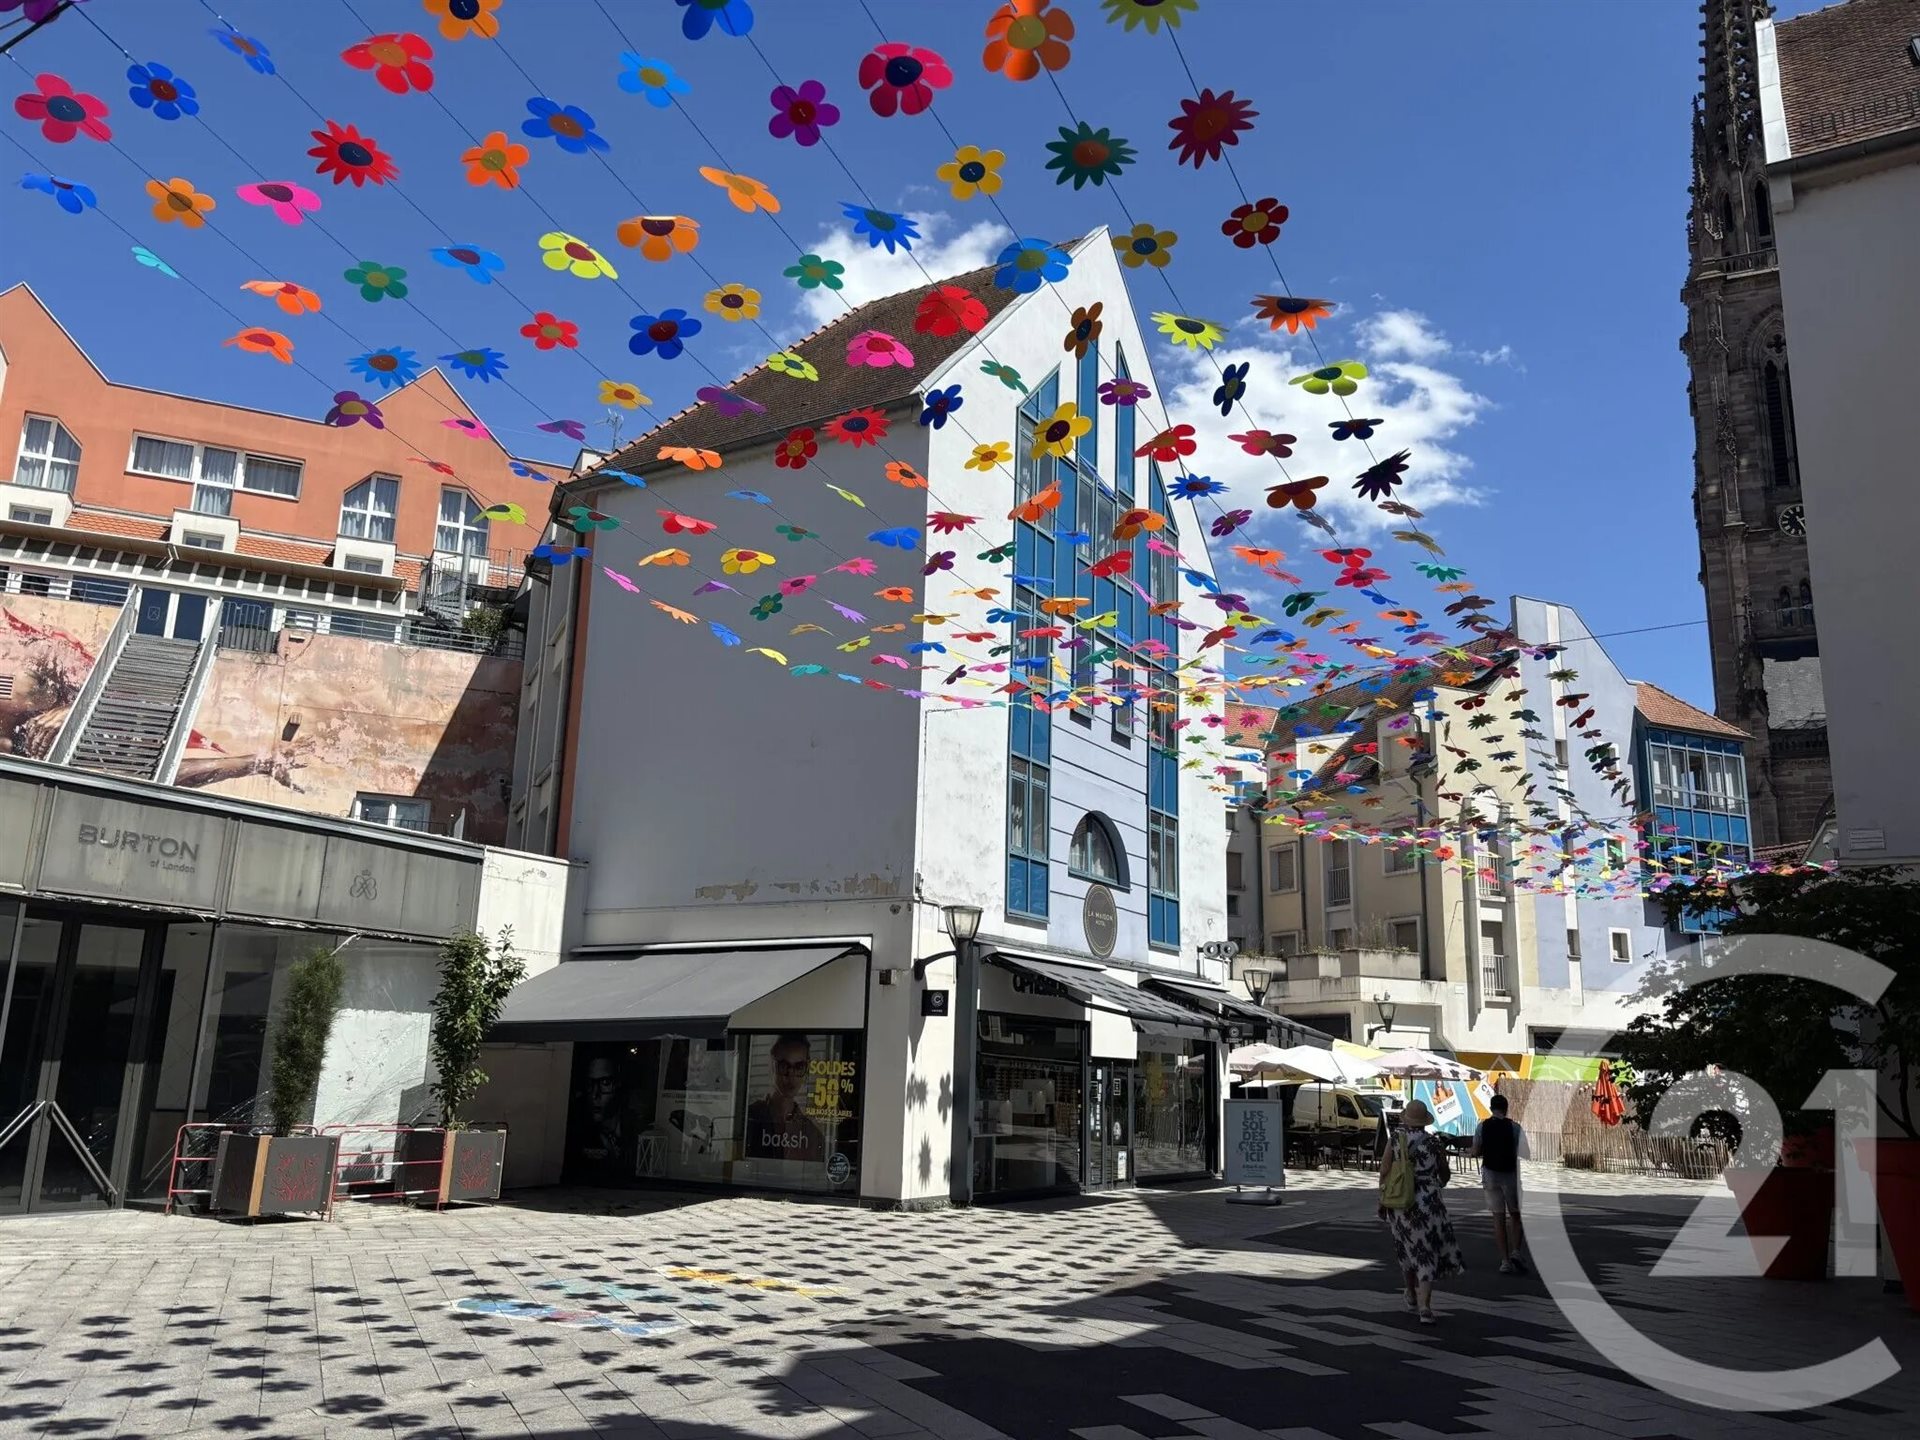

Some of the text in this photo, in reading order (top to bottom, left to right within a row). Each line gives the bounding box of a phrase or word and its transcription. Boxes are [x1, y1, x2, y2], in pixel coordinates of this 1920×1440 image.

[79, 823, 200, 861] BURTON
[150, 860, 196, 873] of London
[809, 1060, 856, 1076] SOLDES
[1243, 1110, 1264, 1120] LES
[1242, 1121, 1266, 1131] SOL
[762, 1129, 809, 1149] ba&sh
[1242, 1131, 1266, 1141] DES
[1245, 1152, 1264, 1162] ICI!
